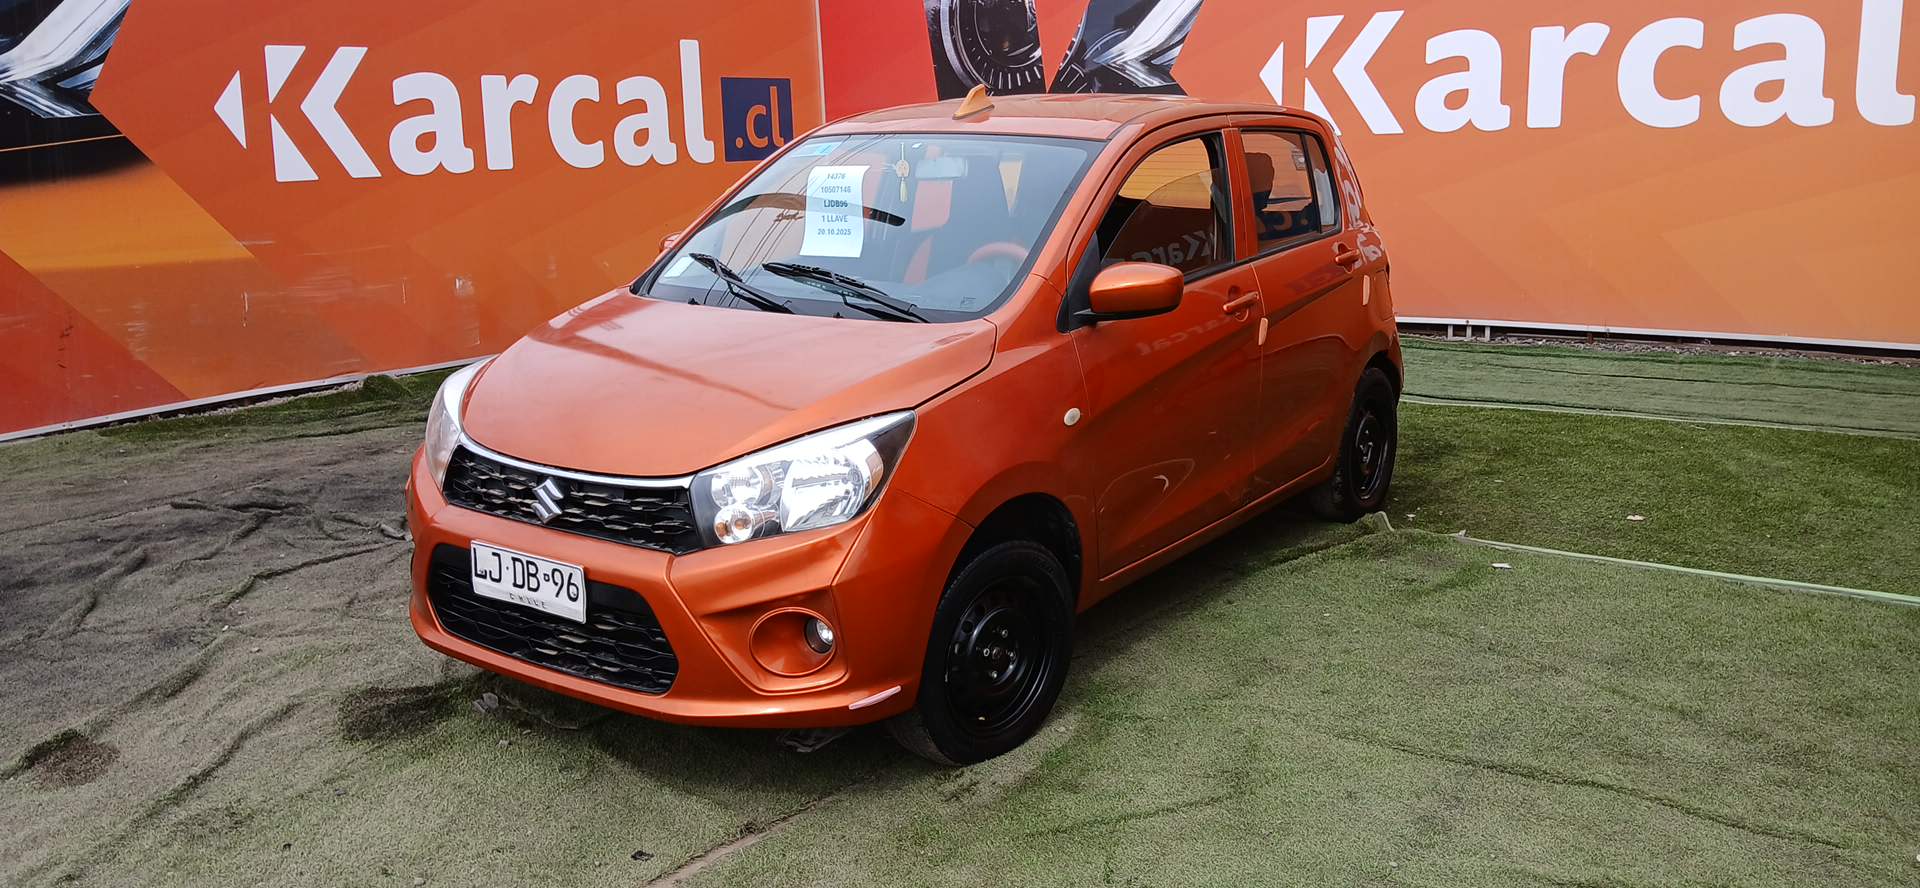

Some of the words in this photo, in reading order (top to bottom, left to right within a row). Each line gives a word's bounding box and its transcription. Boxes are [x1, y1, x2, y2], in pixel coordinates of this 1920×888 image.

[1305, 0, 1916, 135] Karcal
[264, 39, 715, 182] Karcal
[823, 200, 848, 208] LJDB96
[827, 215, 848, 223] LLAVE
[509, 592, 548, 610] CHILE
